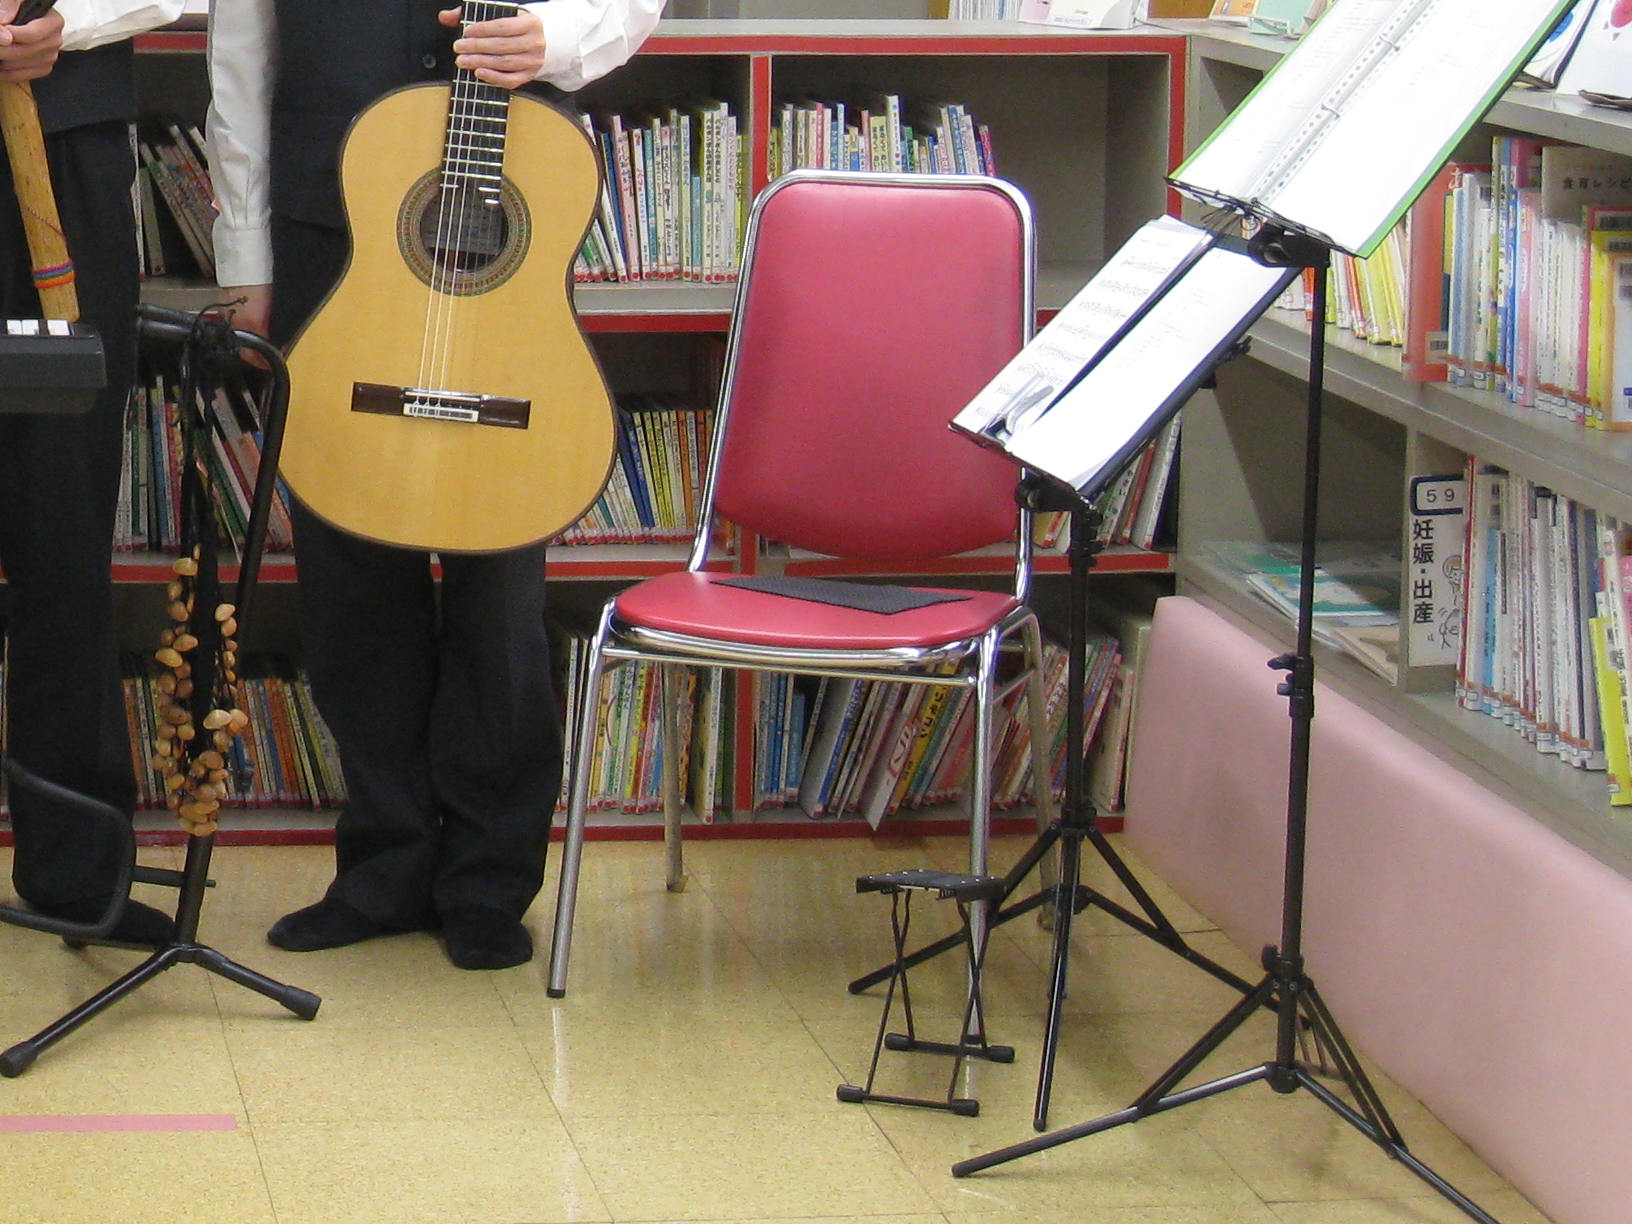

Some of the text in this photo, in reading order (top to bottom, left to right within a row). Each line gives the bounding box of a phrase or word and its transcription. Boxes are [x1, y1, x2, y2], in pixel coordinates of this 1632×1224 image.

[1413, 519, 1435, 625] 妊娠・出産
